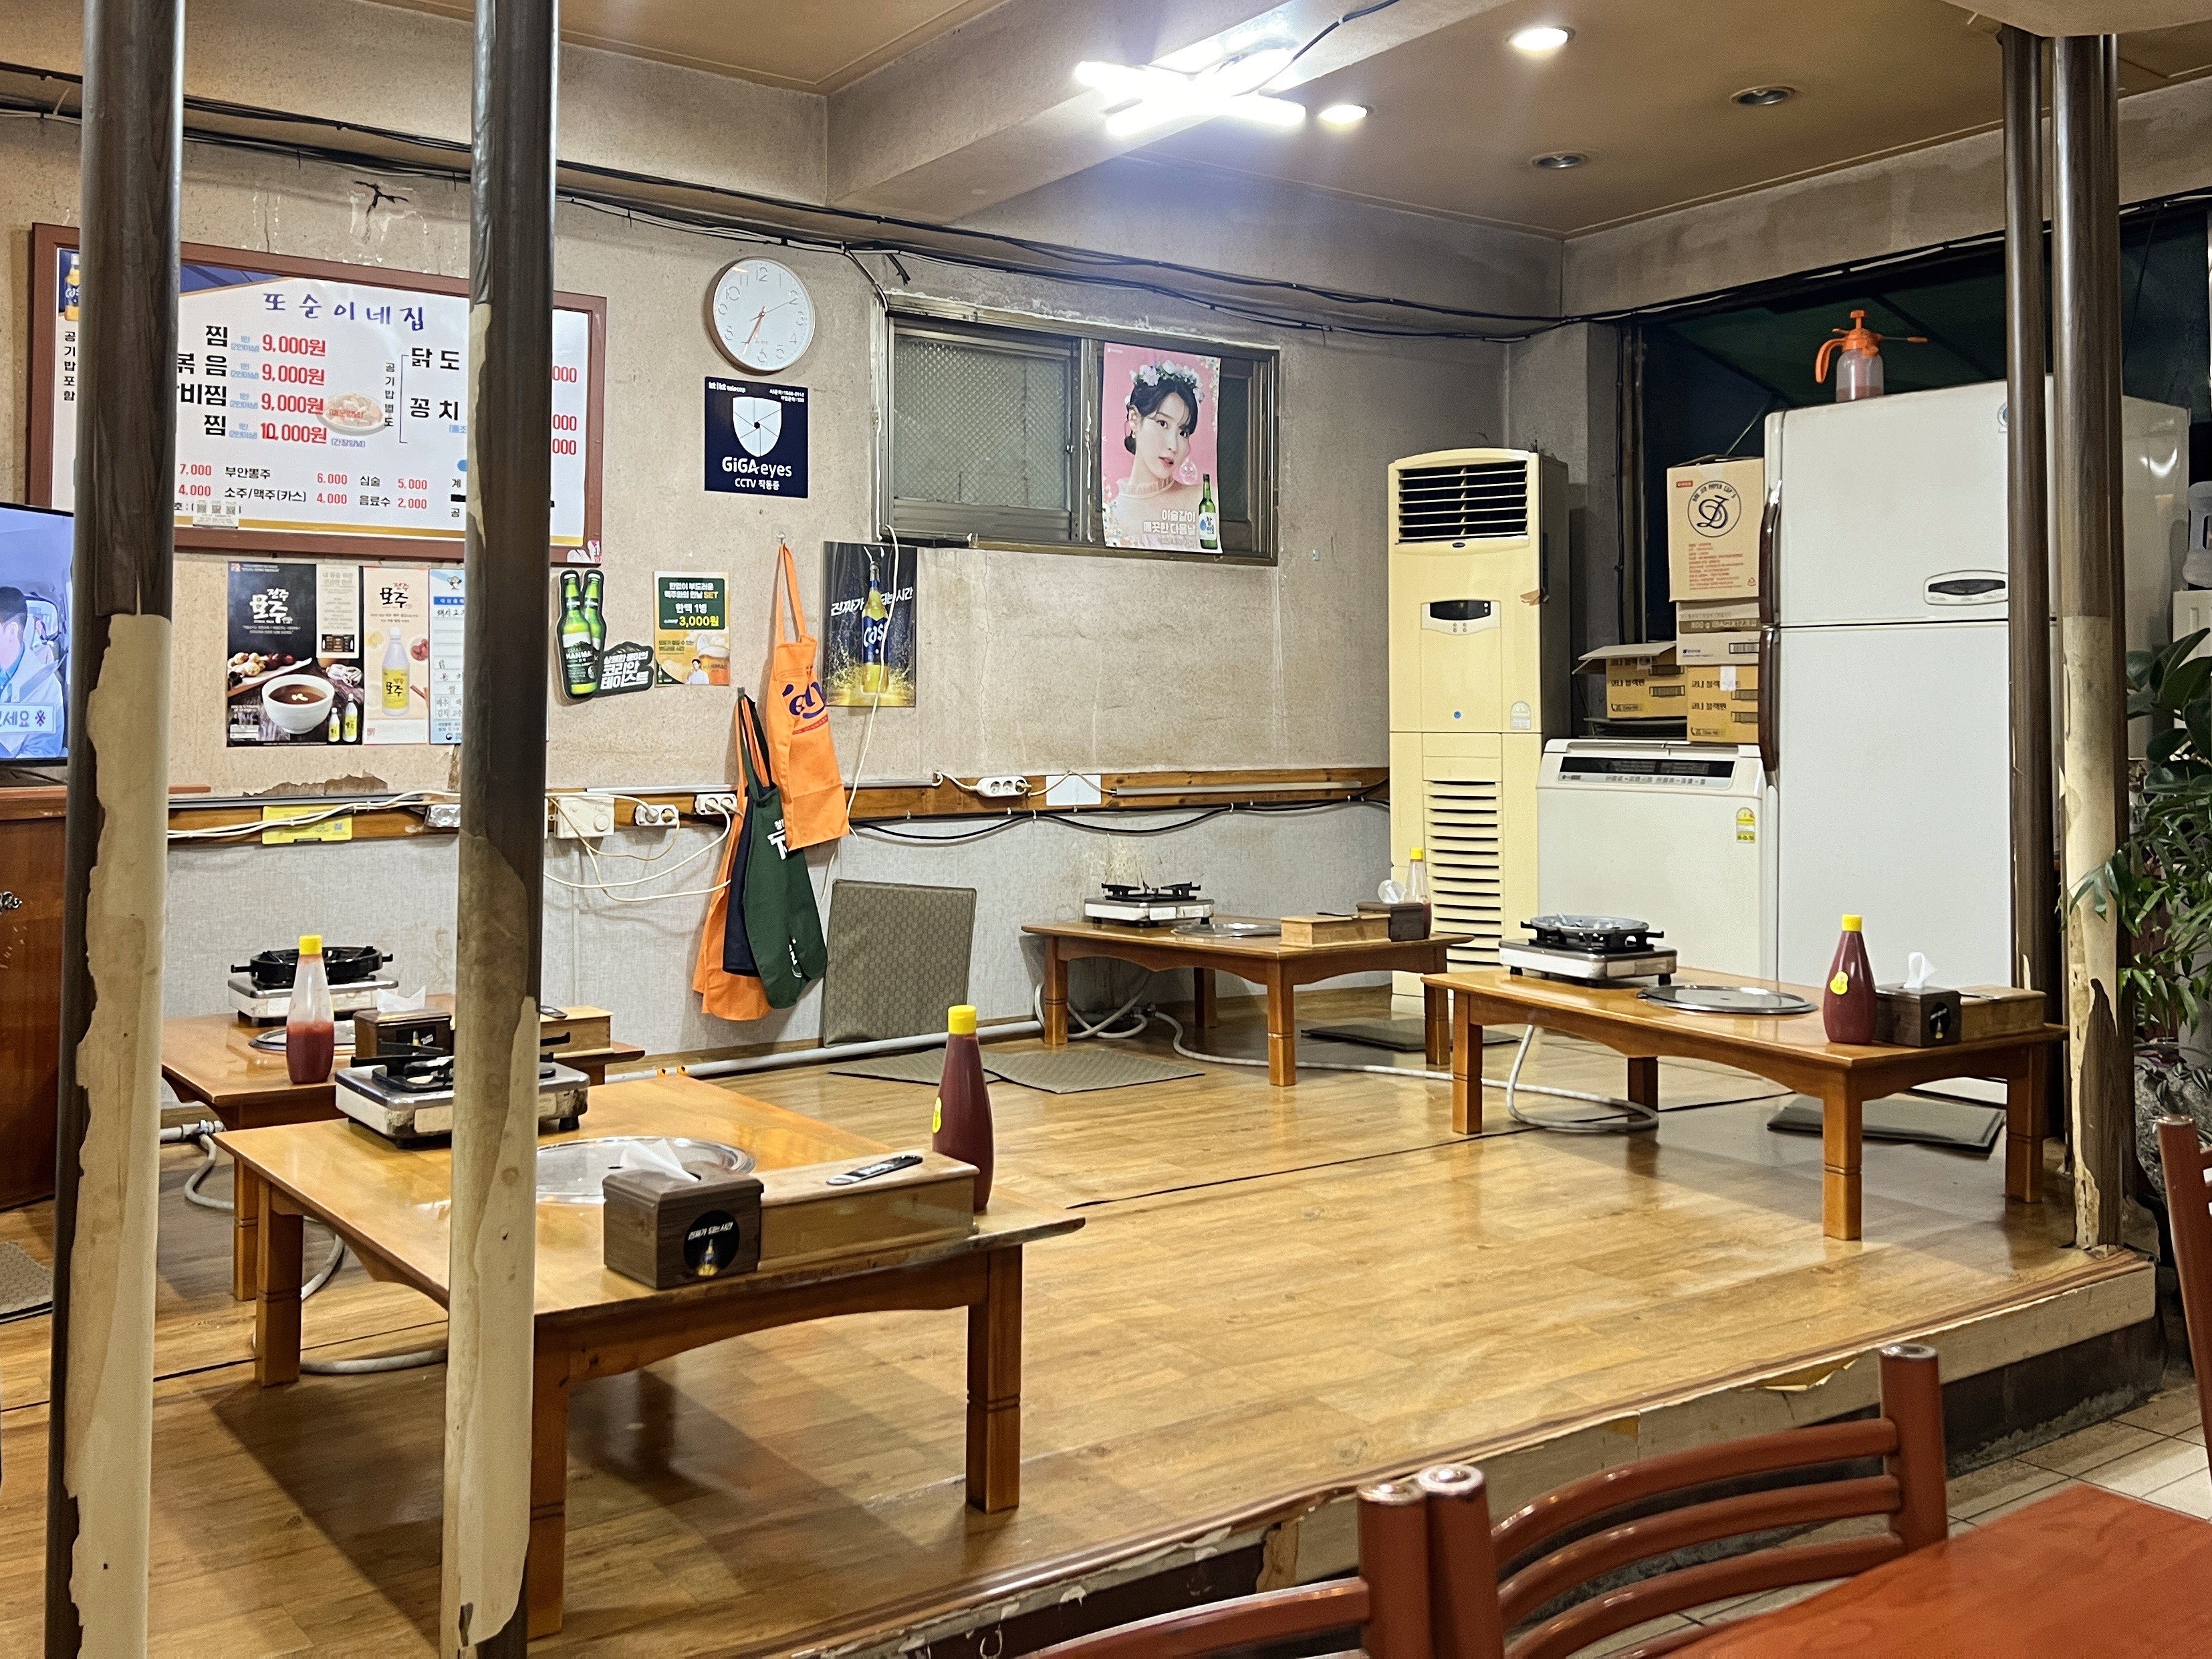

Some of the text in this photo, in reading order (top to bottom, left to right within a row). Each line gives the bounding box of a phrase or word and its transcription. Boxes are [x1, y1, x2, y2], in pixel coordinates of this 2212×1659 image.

[755, 267, 768, 282] 12
[725, 286, 741, 301] 10
[789, 290, 798, 305] 2
[795, 311, 805, 326] 3
[205, 326, 227, 347] 찜
[724, 325, 734, 341] 8
[789, 332, 797, 345] 4
[262, 334, 326, 357] 9,000원
[261, 363, 325, 386] 9,000원
[176, 383, 227, 407] 비찜
[261, 392, 324, 415] 9,000원
[204, 414, 226, 436] 찜
[260, 422, 327, 444] 10,000원
[735, 477, 756, 488] CCTV
[379, 587, 408, 608] 모주
[703, 591, 719, 599] SET
[895, 586, 914, 603] 시간
[679, 616, 719, 628] 3,000원
[0, 710, 29, 727] 세요
